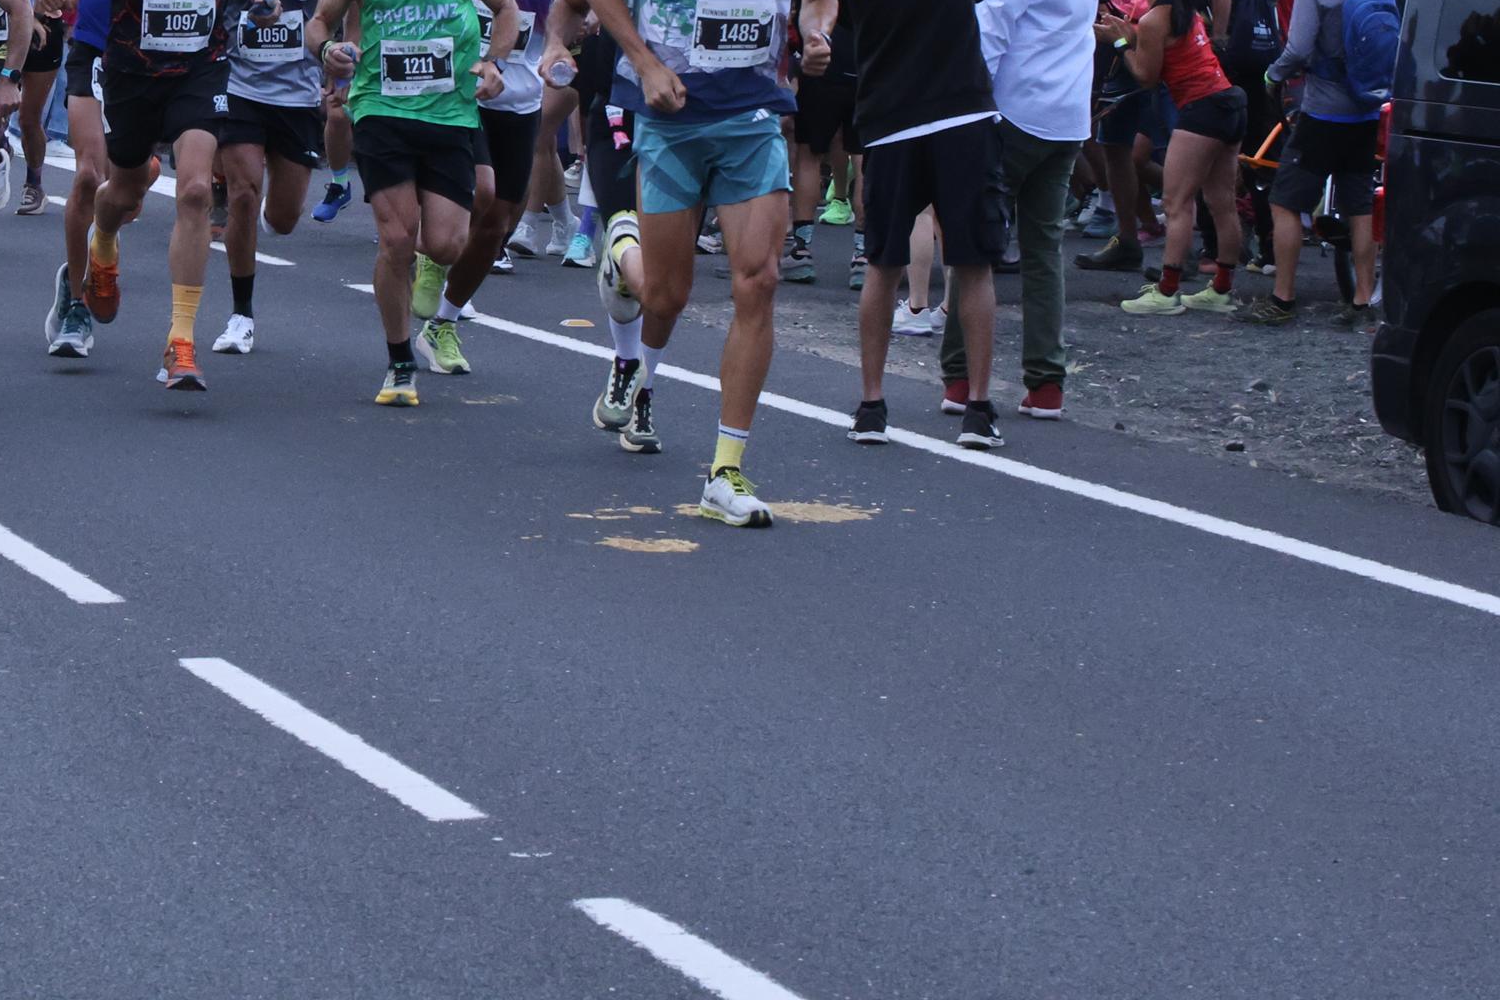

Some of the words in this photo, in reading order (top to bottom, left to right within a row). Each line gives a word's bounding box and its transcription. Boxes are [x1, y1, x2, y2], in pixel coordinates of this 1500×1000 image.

[730, 8, 741, 17] 12
[742, 8, 754, 17] Km
[164, 13, 198, 31] 1097
[256, 27, 288, 43] 1050
[719, 23, 760, 42] 1485
[403, 56, 435, 74] 1211
